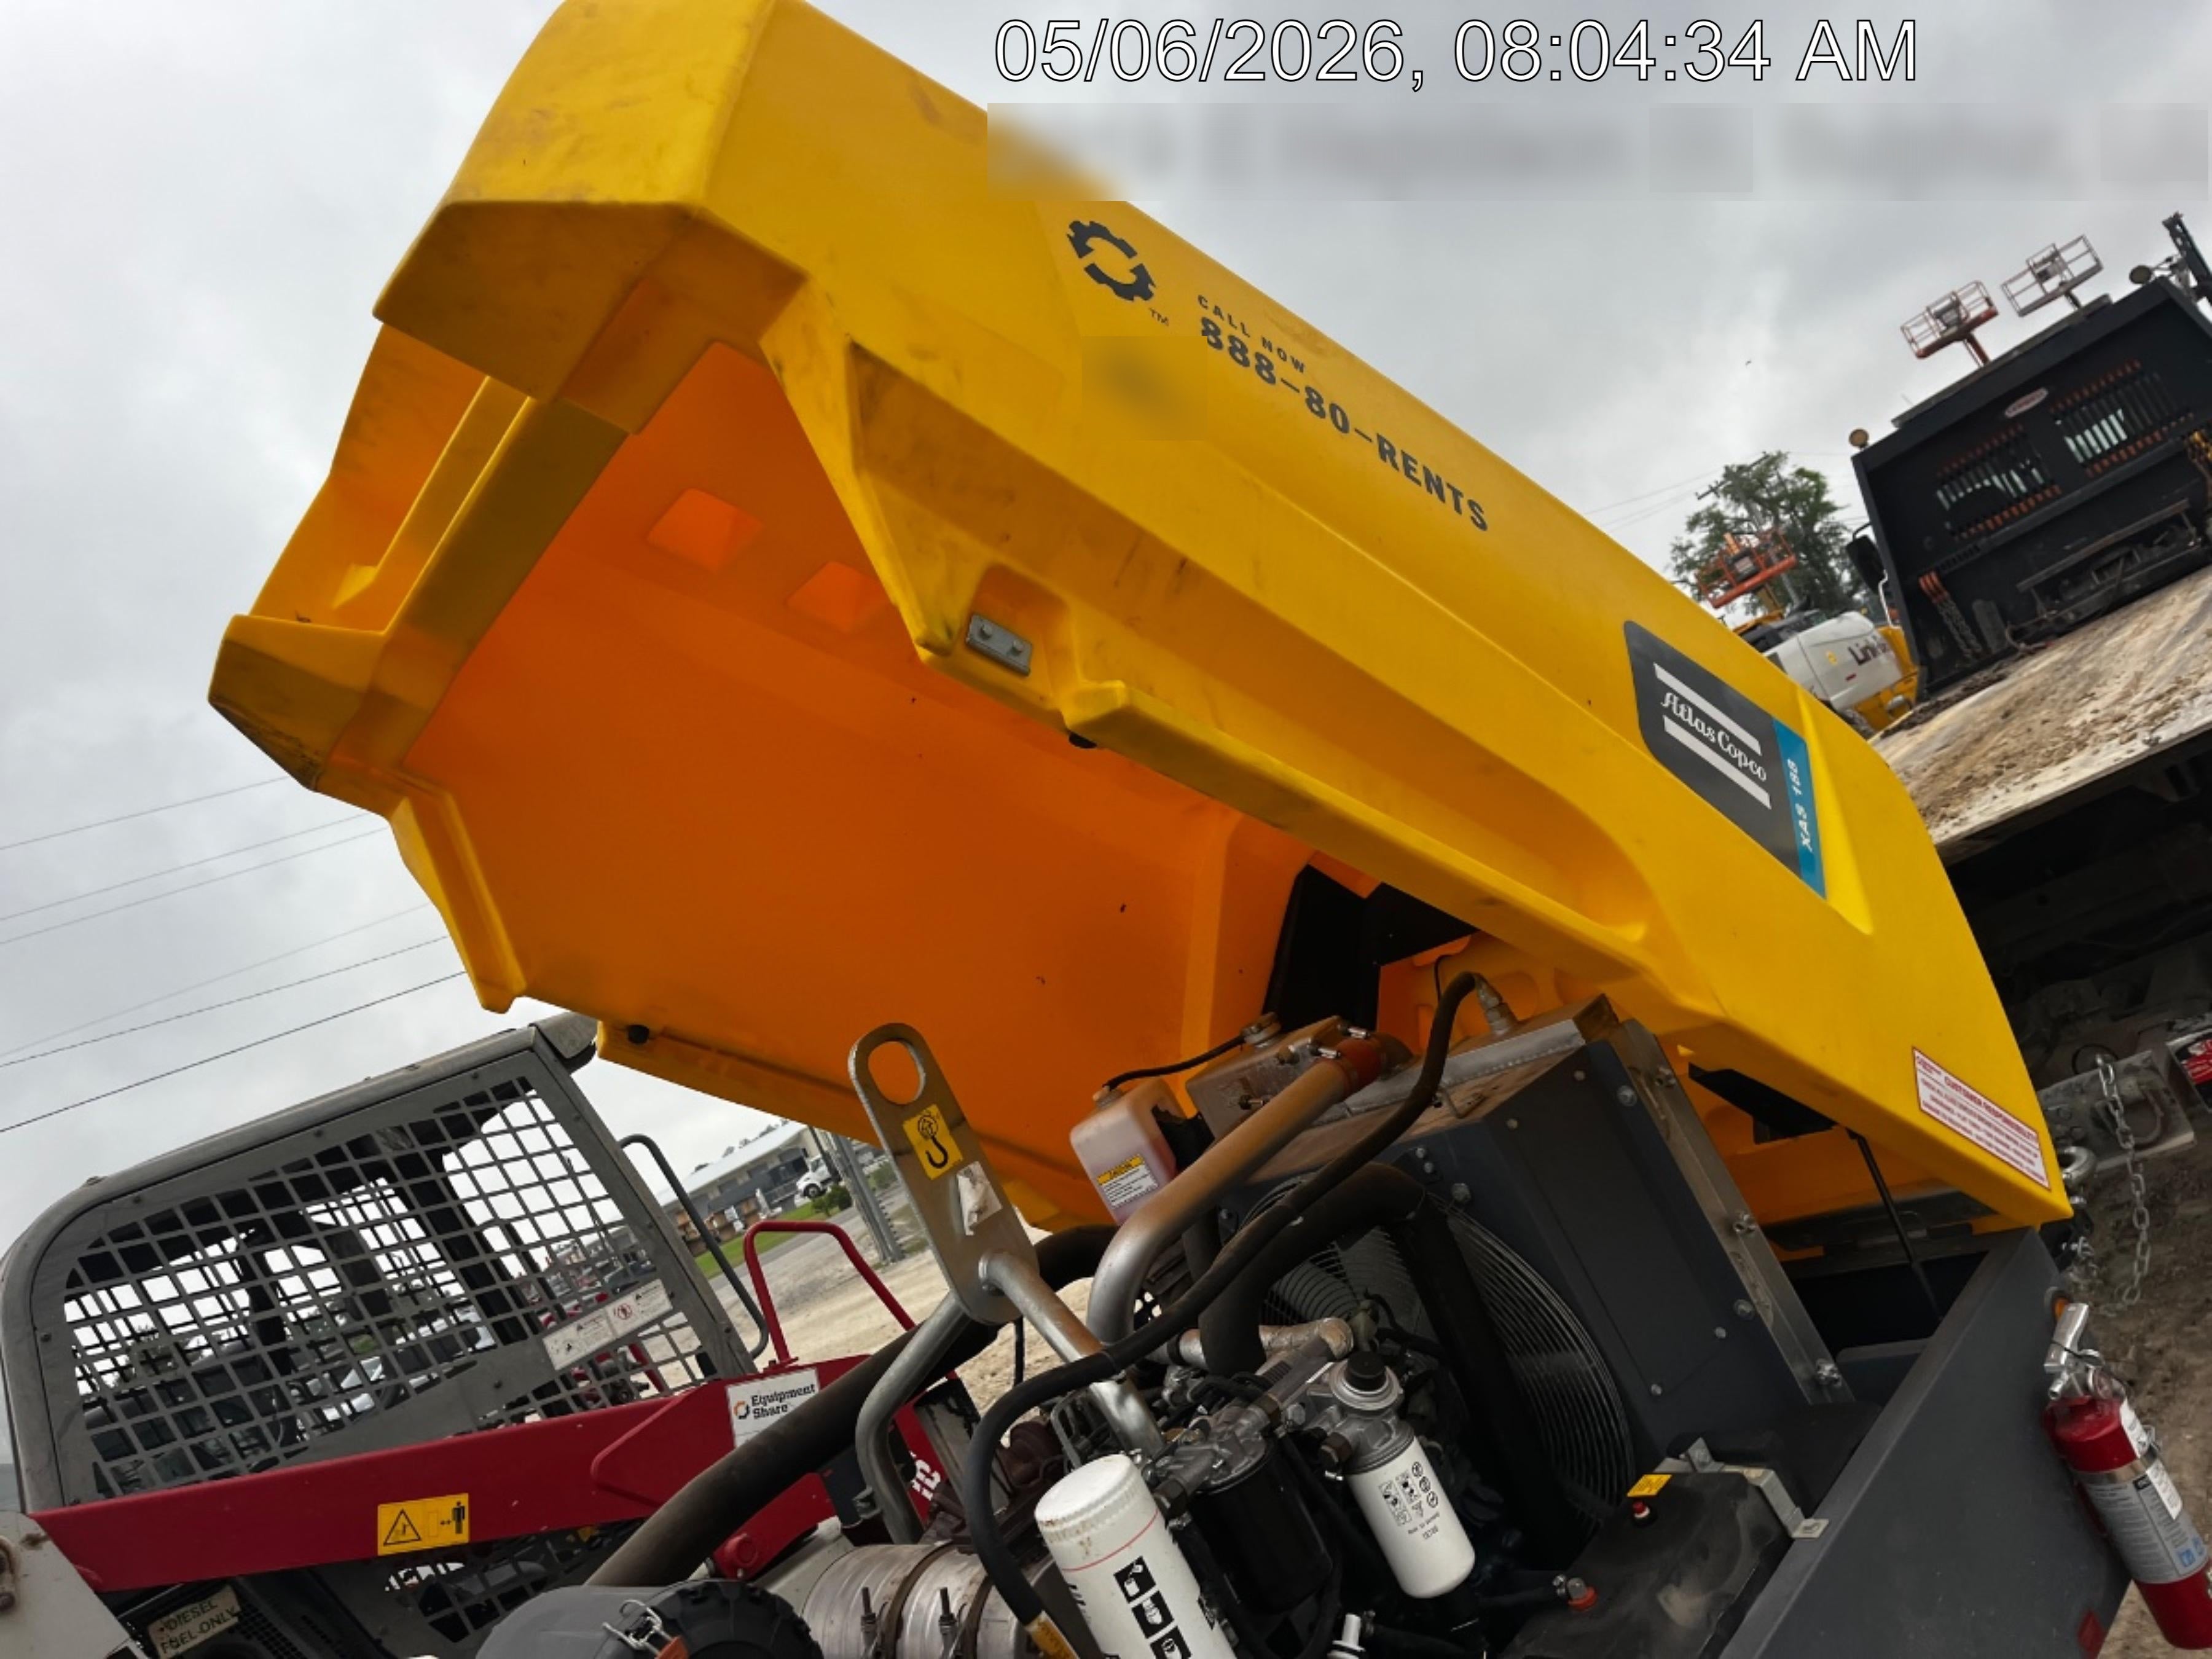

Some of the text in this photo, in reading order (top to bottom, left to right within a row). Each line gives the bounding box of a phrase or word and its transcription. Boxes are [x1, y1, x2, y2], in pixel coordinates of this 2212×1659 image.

[1198, 294, 1305, 374] CALL NOW
[1201, 316, 1488, 532] 888-80-RENTS
[1795, 802, 1813, 853] XAS
[751, 1383, 816, 1408] Equipment
[753, 1403, 788, 1419] Share
[160, 1605, 236, 1654] FUEL ONLY
[163, 1599, 218, 1631] DIESEL
